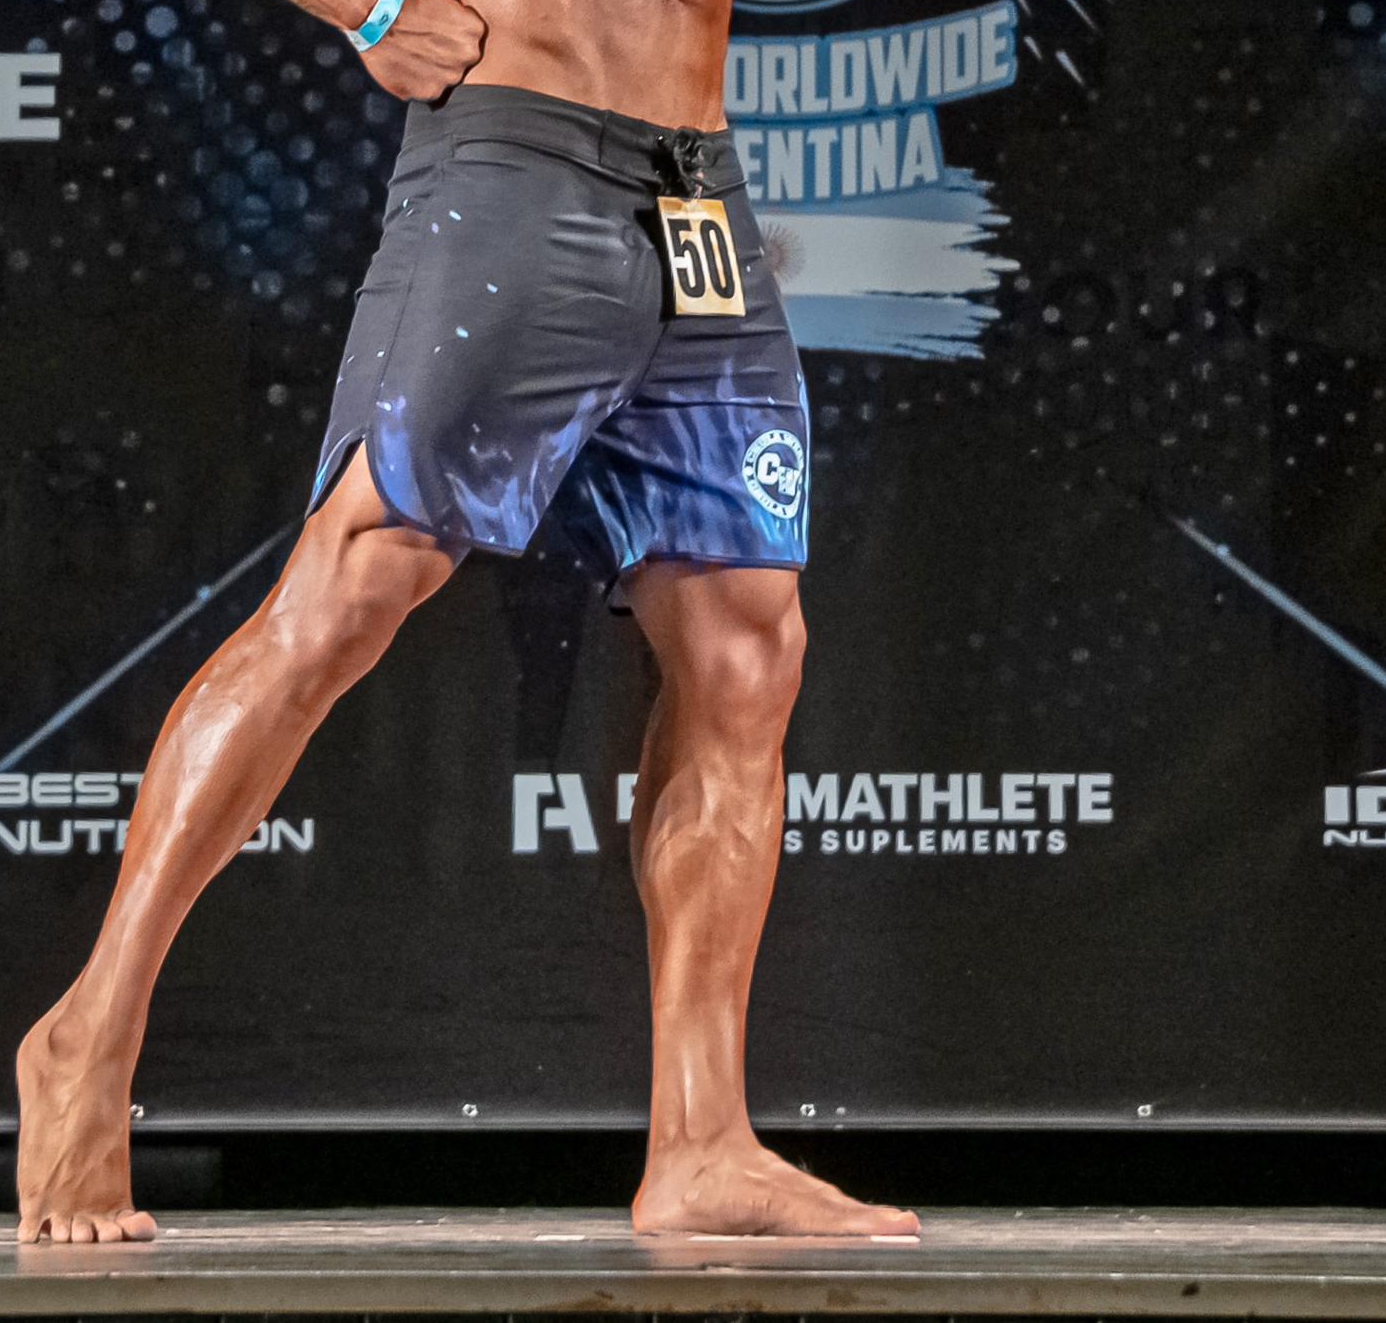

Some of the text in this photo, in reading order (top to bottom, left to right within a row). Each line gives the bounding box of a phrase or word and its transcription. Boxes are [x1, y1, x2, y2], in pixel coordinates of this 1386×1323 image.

[724, 7, 1011, 115] ORLDWIDE
[734, 112, 939, 201] ENTINA
[668, 217, 737, 300] 50
[820, 828, 1067, 855] SUPLEMENTS
